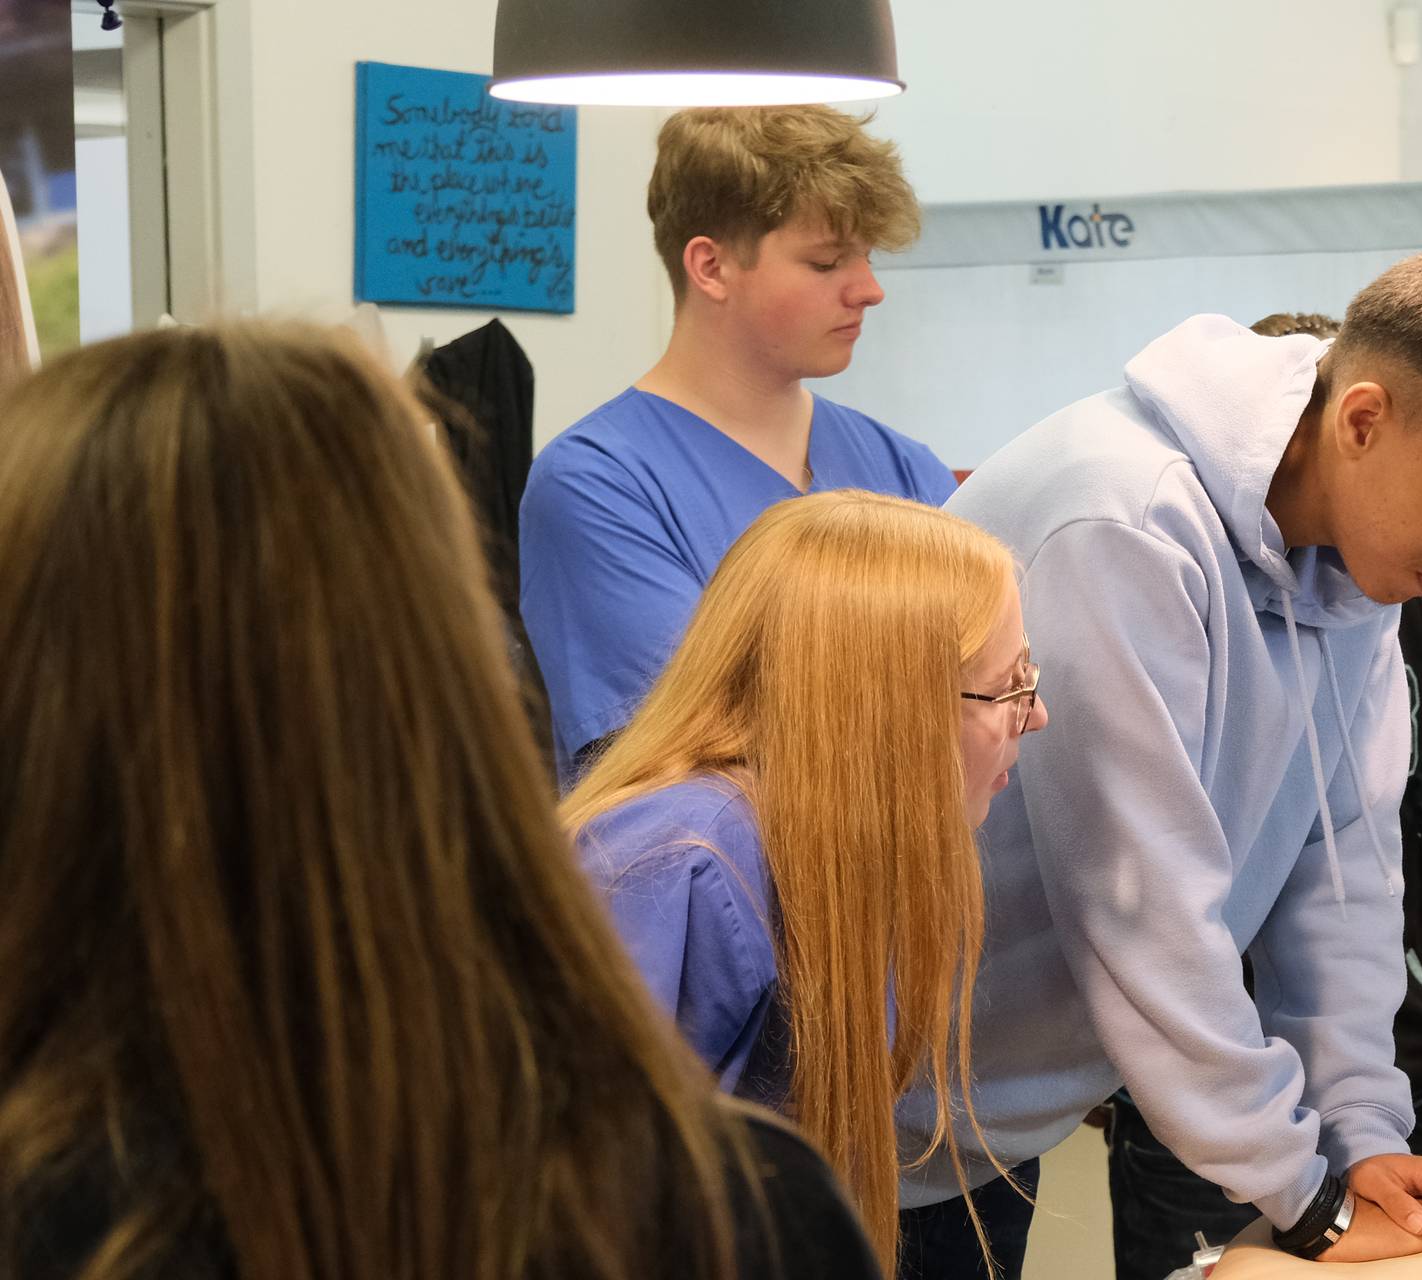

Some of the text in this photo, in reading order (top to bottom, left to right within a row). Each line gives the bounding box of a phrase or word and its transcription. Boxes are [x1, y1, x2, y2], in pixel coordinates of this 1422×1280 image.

[383, 94, 500, 132] Somebody
[375, 130, 549, 168] me that this is
[388, 229, 428, 257] and
[1039, 203, 1136, 250] Kate
